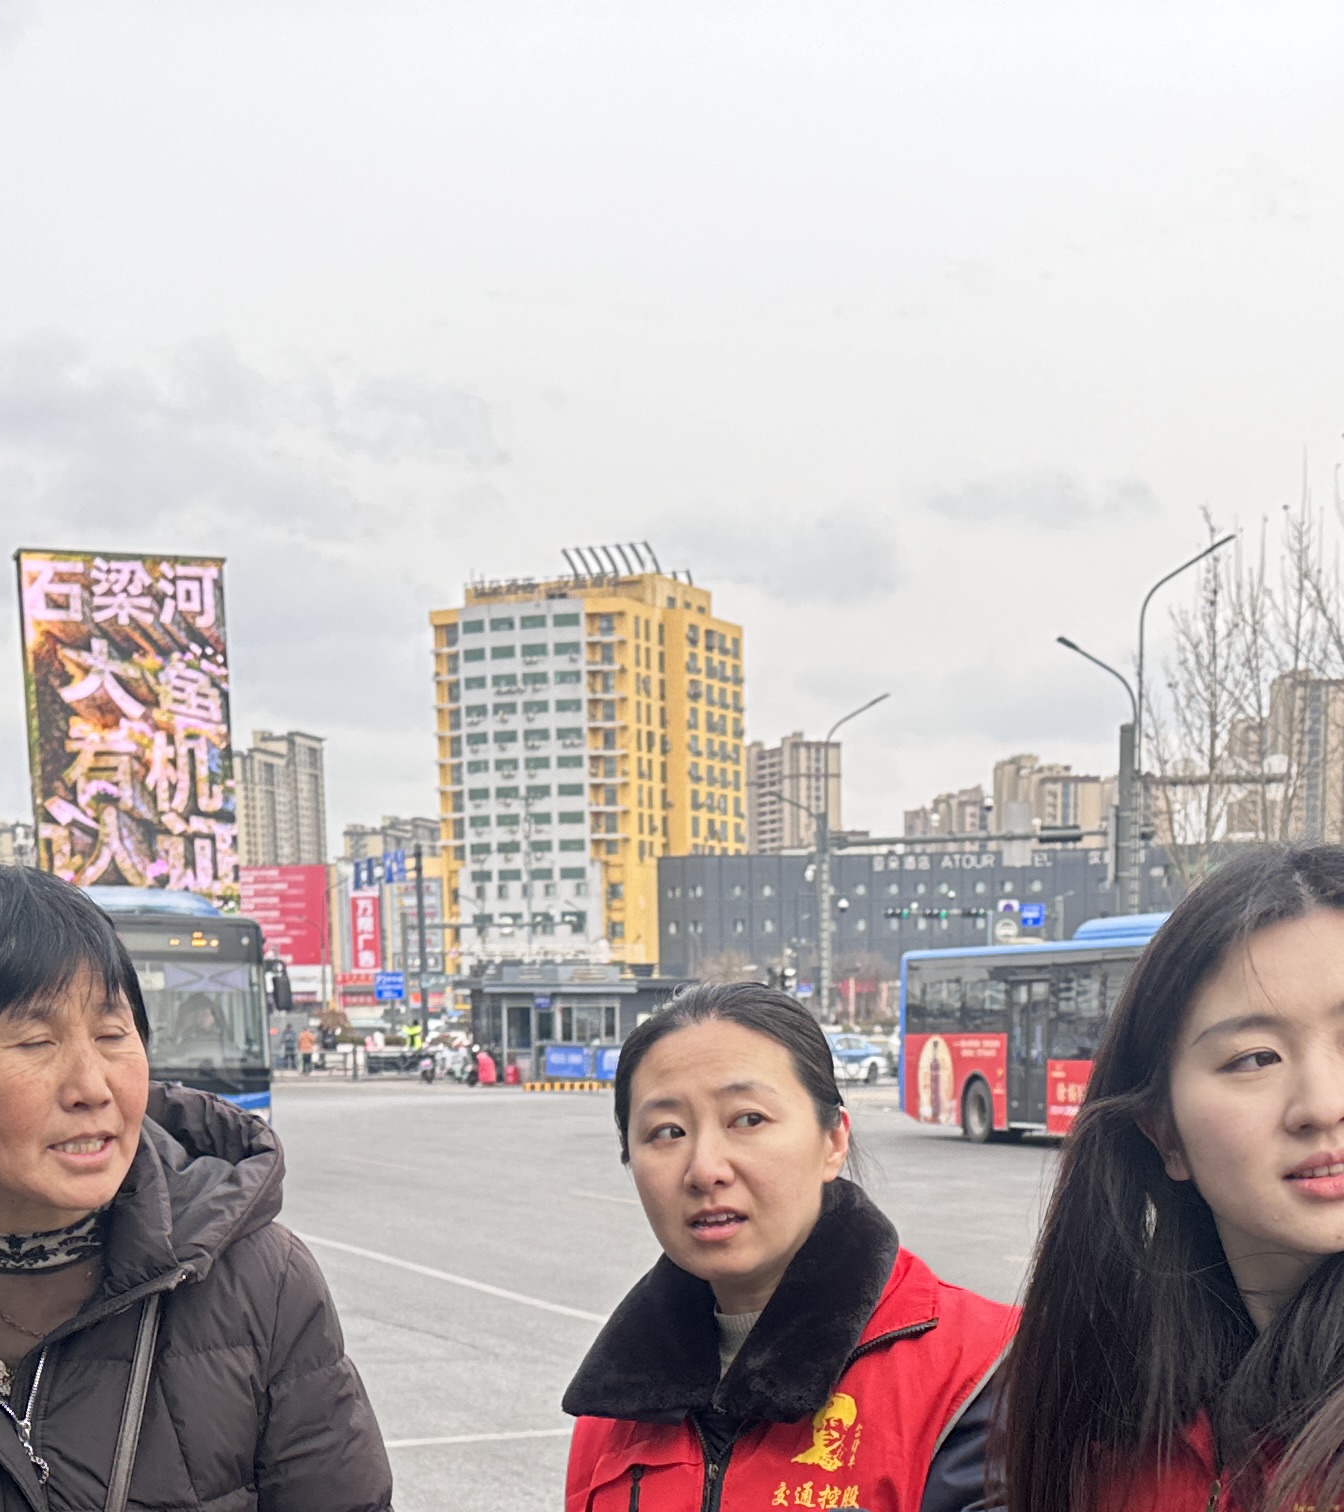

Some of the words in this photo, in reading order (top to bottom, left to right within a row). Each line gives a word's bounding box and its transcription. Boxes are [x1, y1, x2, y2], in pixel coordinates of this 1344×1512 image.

[22, 556, 220, 628] 石梁河
[941, 853, 996, 870] ATOUR
[771, 1481, 860, 1510] 交通控股
